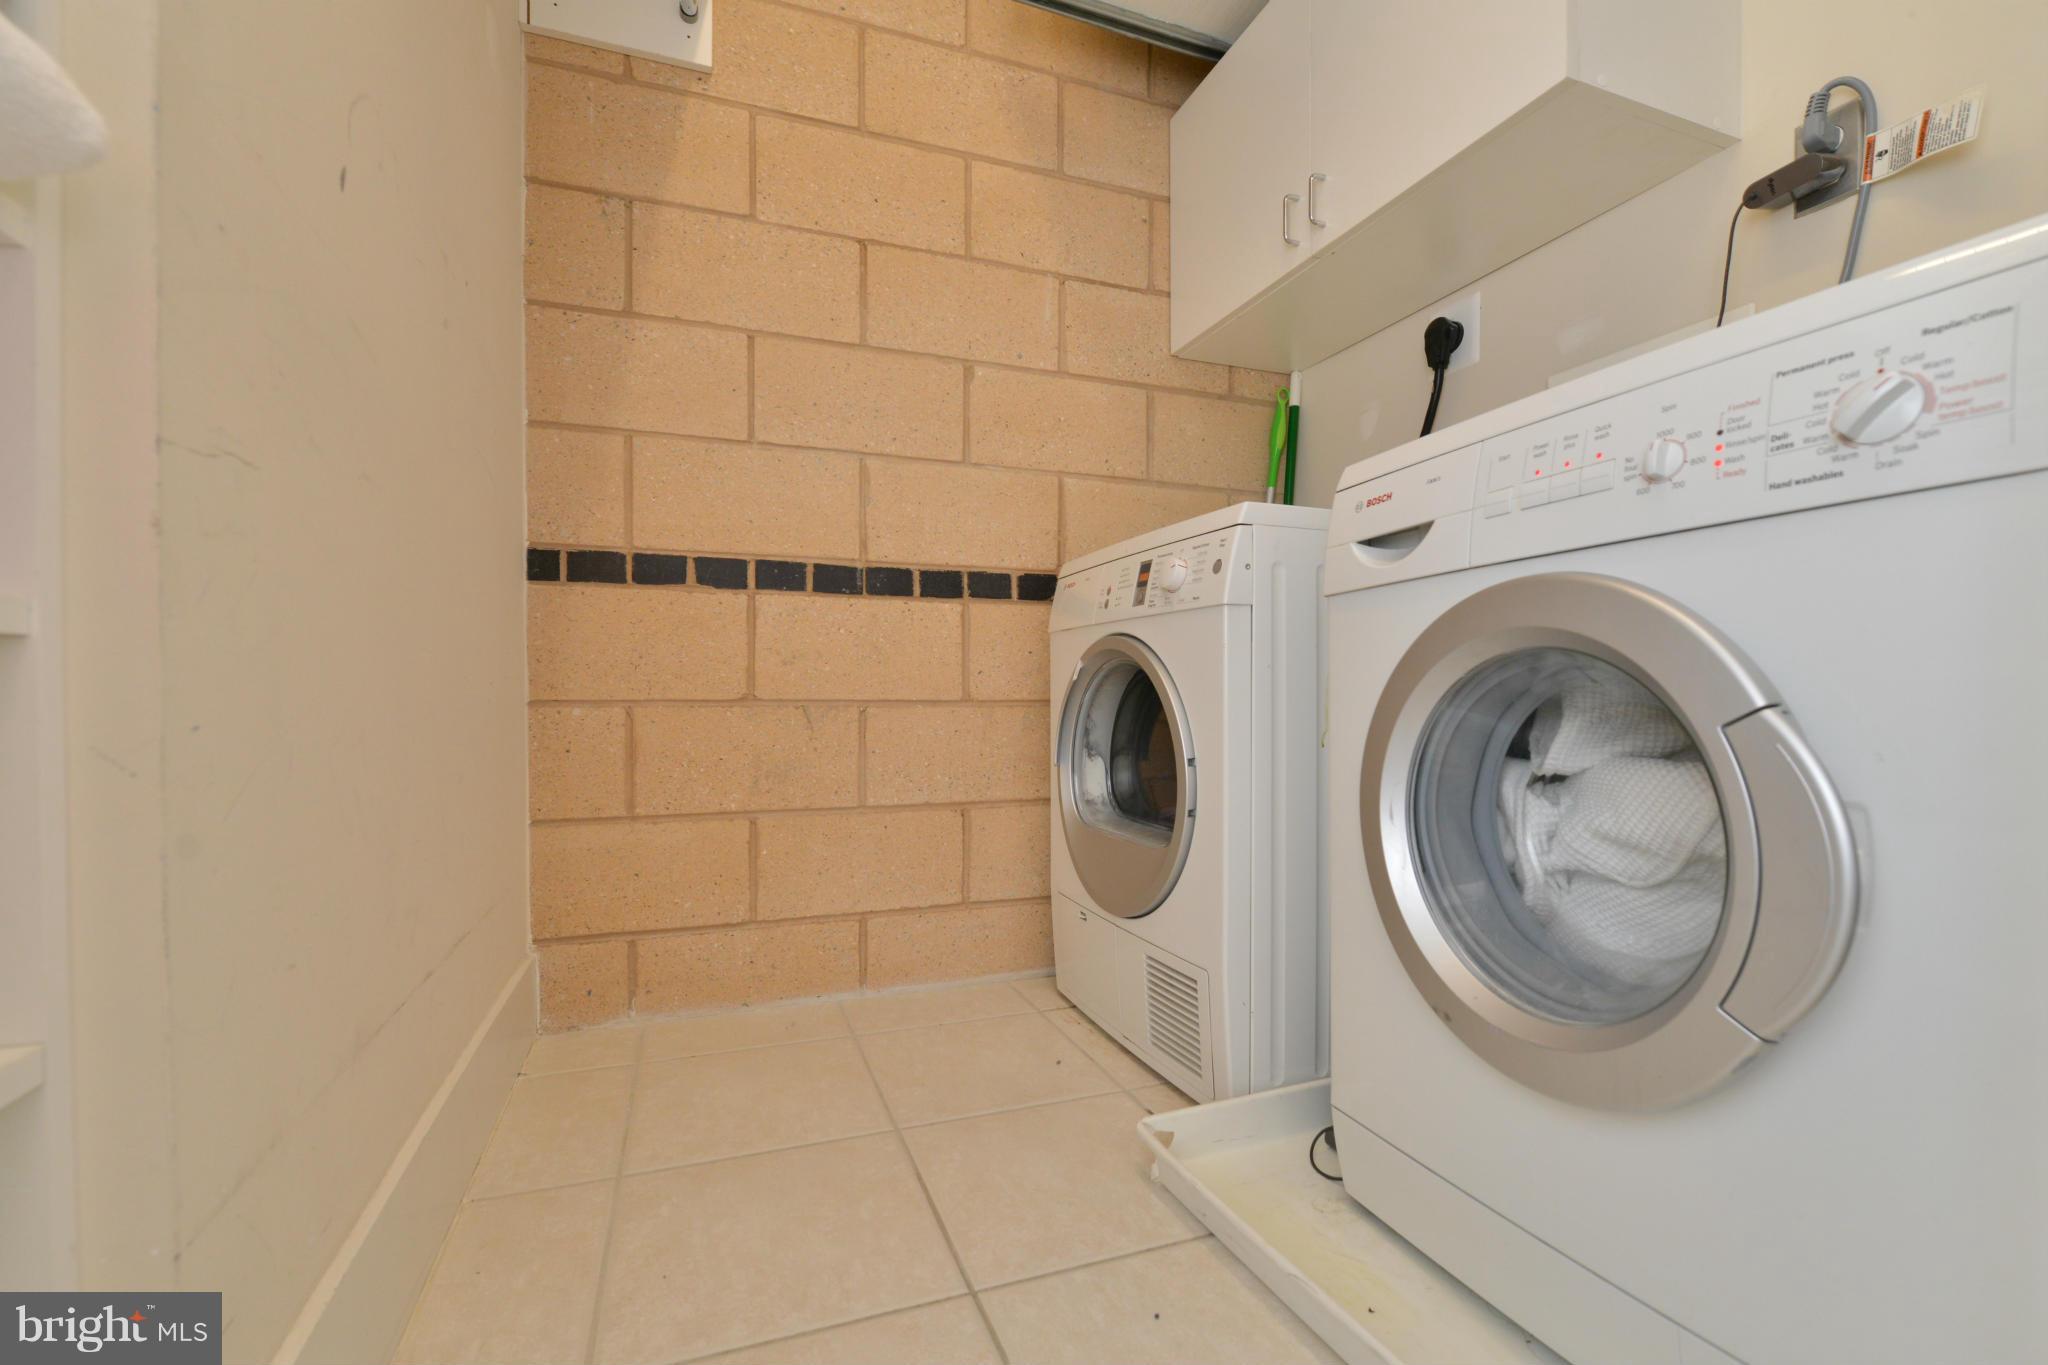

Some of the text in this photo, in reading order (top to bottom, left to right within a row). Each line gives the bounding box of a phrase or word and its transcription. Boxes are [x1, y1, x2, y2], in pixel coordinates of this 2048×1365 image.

[1776, 351, 1855, 379] Permanent press
[1899, 351, 1925, 366] Cold
[1922, 356, 1954, 371] Warm
[1838, 369, 1861, 382] Cold
[1813, 387, 1841, 399] Warm
[1805, 418, 1828, 430] Cold
[1769, 441, 1796, 453] cates
[1768, 470, 1845, 490] Hand washables
[1366, 491, 1393, 508] BOSCH
